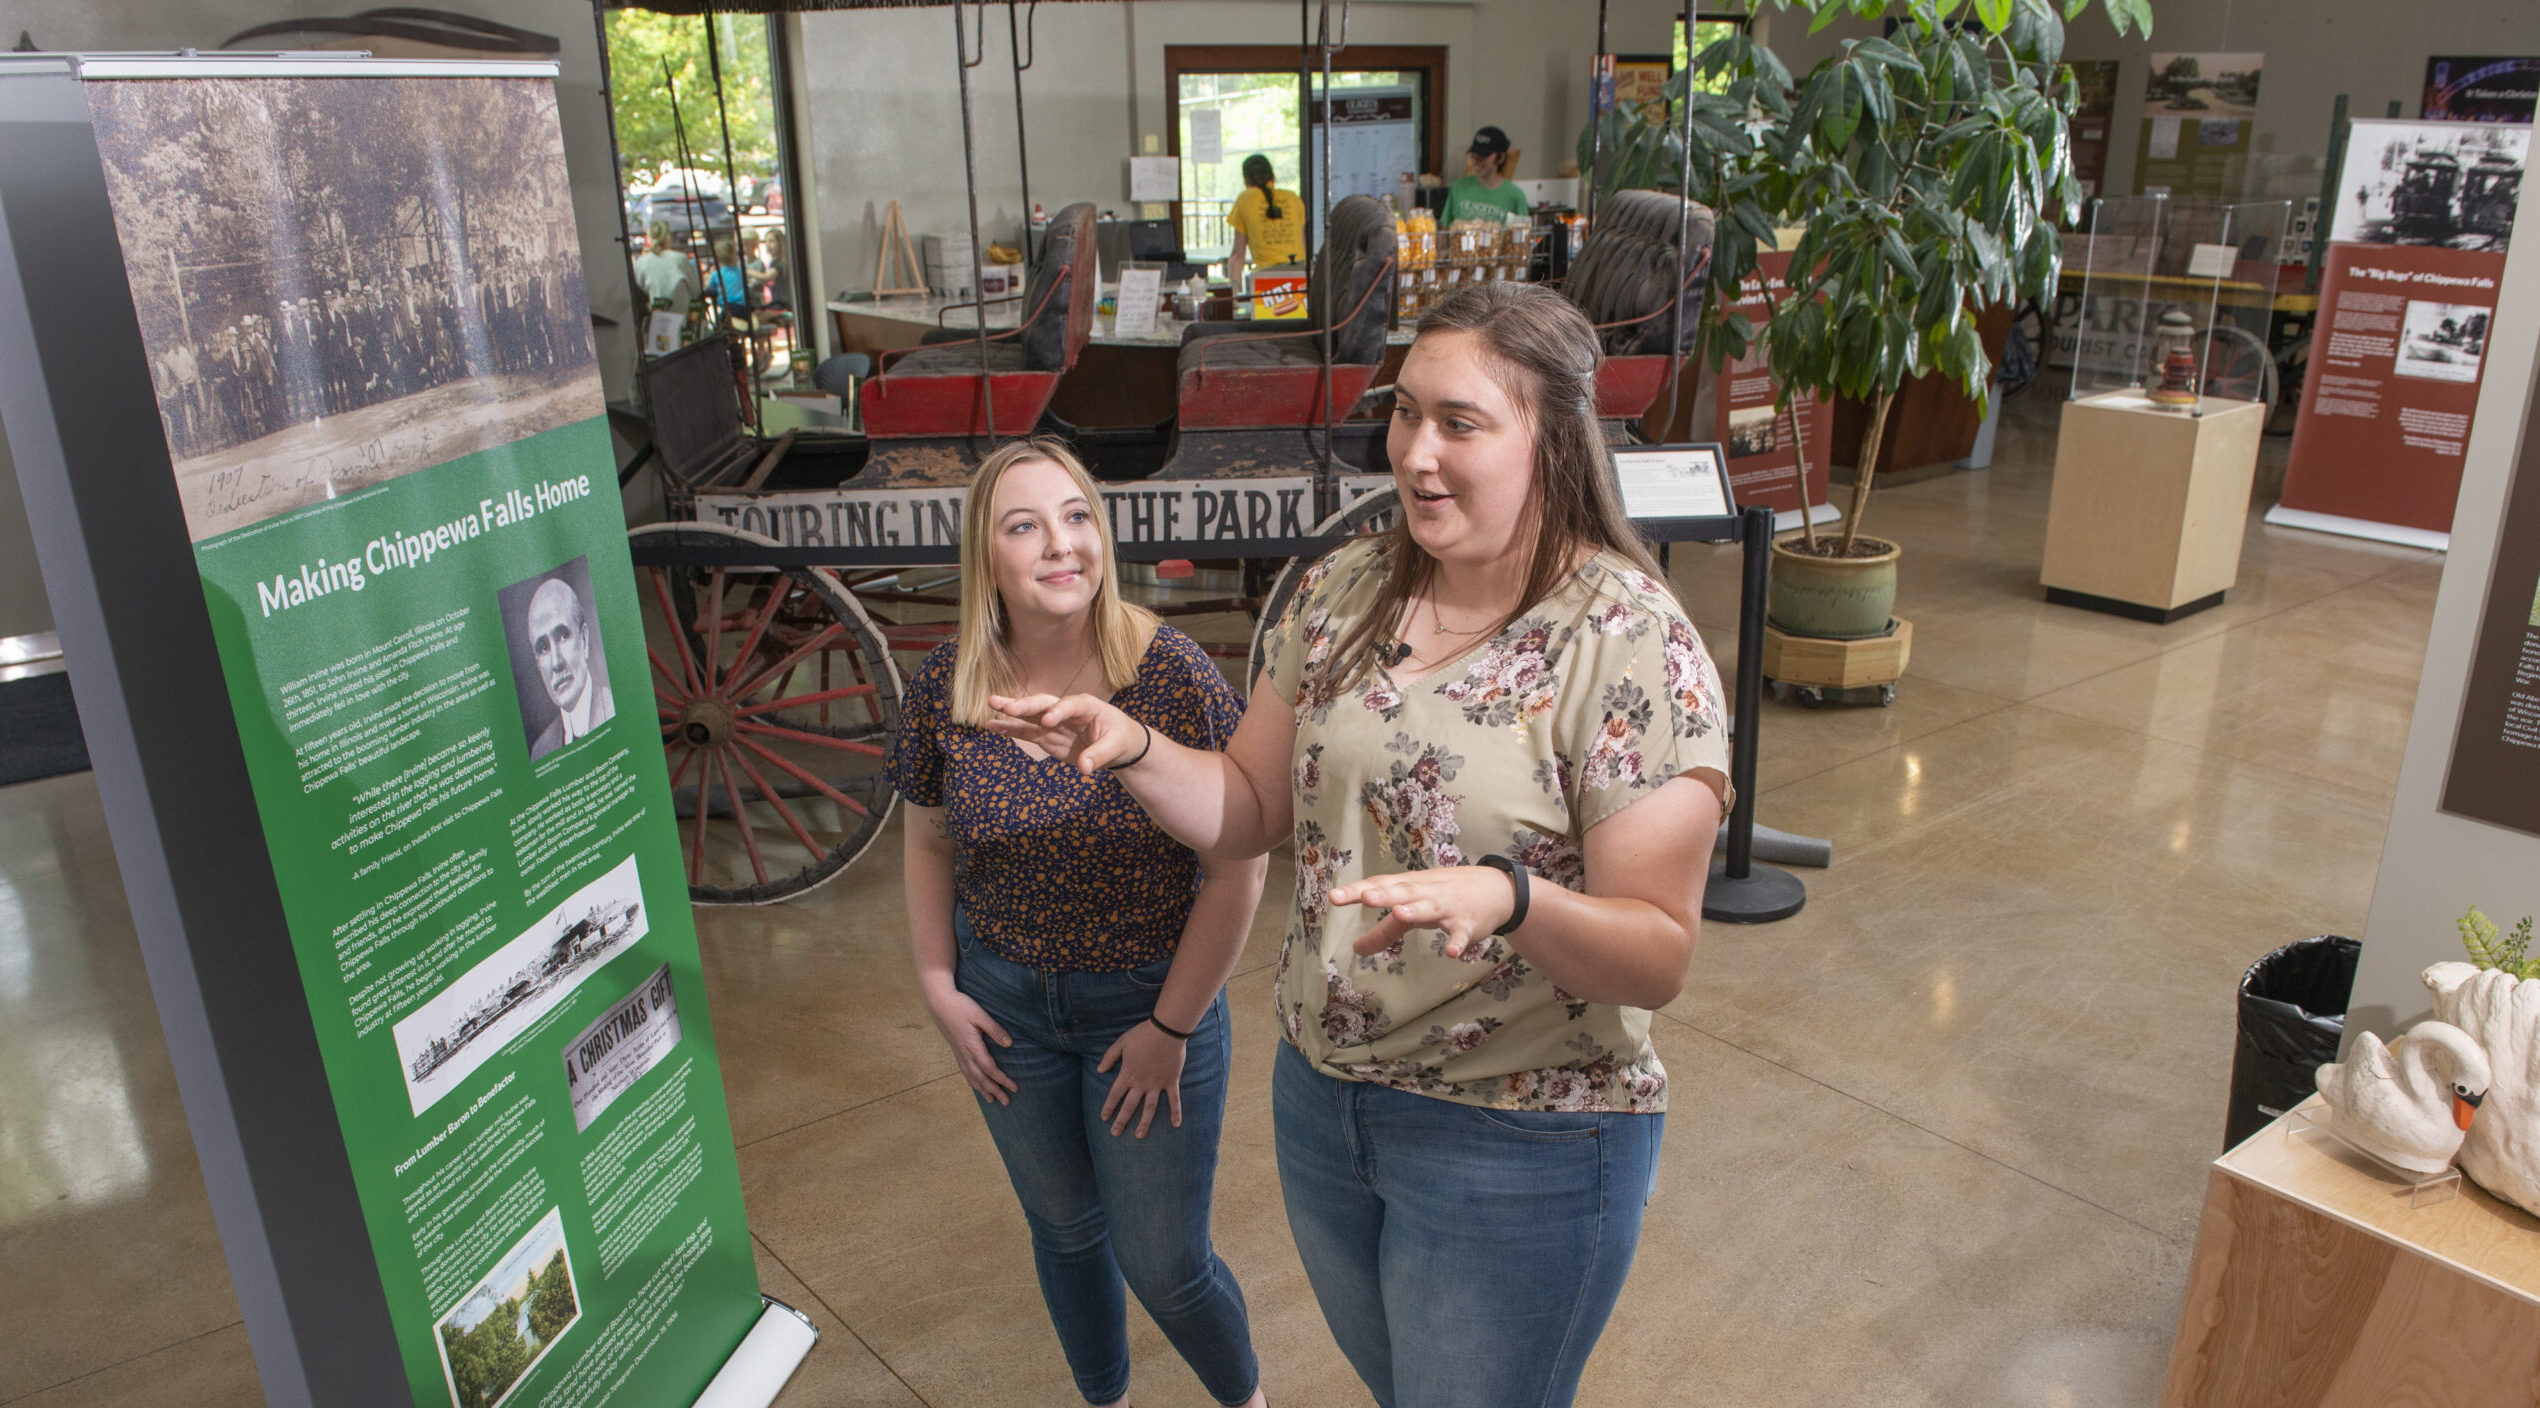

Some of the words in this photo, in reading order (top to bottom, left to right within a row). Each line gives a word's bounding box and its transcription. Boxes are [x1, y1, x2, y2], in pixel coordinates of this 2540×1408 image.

[1261, 282, 1292, 307] HOT
[2349, 266, 2366, 277] The
[2412, 273, 2423, 282] of
[2424, 273, 2470, 287] Chippewa
[2471, 276, 2494, 288] Falls
[257, 558, 365, 617] Making
[366, 514, 479, 574] Chippewa
[480, 490, 534, 532] Falls
[535, 475, 590, 513] Home
[909, 498, 962, 546] IN
[1102, 491, 1182, 542] THE
[1192, 489, 1305, 541] PARK
[280, 678, 307, 695] William
[308, 668, 328, 682] Irvine
[329, 662, 345, 672] was
[344, 654, 363, 666] born
[364, 650, 371, 659] in
[372, 640, 392, 654] Mount
[414, 621, 436, 635] Illinois
[436, 618, 445, 626] on
[445, 607, 469, 622] October
[317, 691, 337, 705] Irvine
[338, 679, 362, 695] visited
[363, 675, 374, 684] his
[375, 667, 391, 680] sister
[392, 664, 398, 672] in
[399, 648, 430, 667] Chippewa
[430, 641, 445, 653] Falls
[445, 634, 458, 647] and
[318, 683, 326, 691] to
[327, 674, 345, 688] John
[346, 665, 368, 678] Irvine
[368, 658, 381, 670] and
[382, 646, 407, 664] Amanda
[408, 638, 424, 650] Fitch
[445, 626, 453, 634] At
[289, 706, 333, 733] immediately
[333, 700, 345, 710] fell
[346, 697, 354, 705] in
[355, 691, 370, 702] love
[370, 682, 386, 695] with
[386, 677, 397, 687] the
[296, 746, 304, 758] At
[304, 736, 327, 752] fifteen
[328, 727, 348, 743] years
[363, 710, 383, 724] Irvine
[384, 701, 401, 714] made
[401, 695, 412, 705] the
[413, 682, 438, 699] decision
[446, 670, 464, 683] move
[464, 663, 479, 675] from
[298, 759, 309, 769] his
[309, 748, 330, 763] home
[330, 744, 338, 753] in
[339, 732, 363, 748] Illinois
[364, 724, 377, 737] and
[378, 716, 396, 730] make
[402, 704, 419, 717] home
[420, 700, 426, 708] in
[460, 676, 478, 688] Irvine
[477, 670, 489, 680] was
[301, 758, 333, 782] attracted
[333, 756, 342, 764] to
[341, 750, 355, 760] the
[355, 734, 388, 754] booming
[388, 722, 409, 738] lumber
[411, 708, 435, 725] industry
[443, 699, 454, 709] the
[454, 692, 469, 703] area
[469, 688, 477, 696] as
[476, 681, 488, 692] well
[304, 771, 338, 793] Chippewa
[358, 744, 389, 766] beautiful
[349, 794, 391, 824] interested
[392, 792, 399, 801] in
[400, 784, 412, 796] the
[414, 768, 439, 788] logging
[440, 757, 455, 773] and
[456, 740, 492, 764] lumbering
[382, 776, 402, 792] there
[458, 740, 466, 749] so
[467, 728, 490, 744] keenly
[331, 824, 368, 849] activities
[368, 818, 380, 829] on
[381, 810, 395, 822] the
[396, 799, 412, 814] river
[413, 789, 428, 803] that
[428, 784, 438, 794] he
[439, 775, 453, 788] was
[455, 751, 494, 779] determined
[349, 845, 358, 854] to
[359, 831, 383, 848] make
[385, 808, 422, 834] Chippewa
[422, 798, 438, 812] Falls
[439, 791, 449, 803] his
[450, 779, 472, 796] future
[567, 1059, 577, 1087] A
[579, 998, 648, 1073] CHRISTMAS
[651, 971, 672, 1011] GIFT
[394, 1156, 416, 1176] From
[416, 1130, 446, 1159] Lumber
[447, 1112, 469, 1135] Baron
[469, 1104, 477, 1115] to
[477, 1072, 515, 1108] Benefactor
